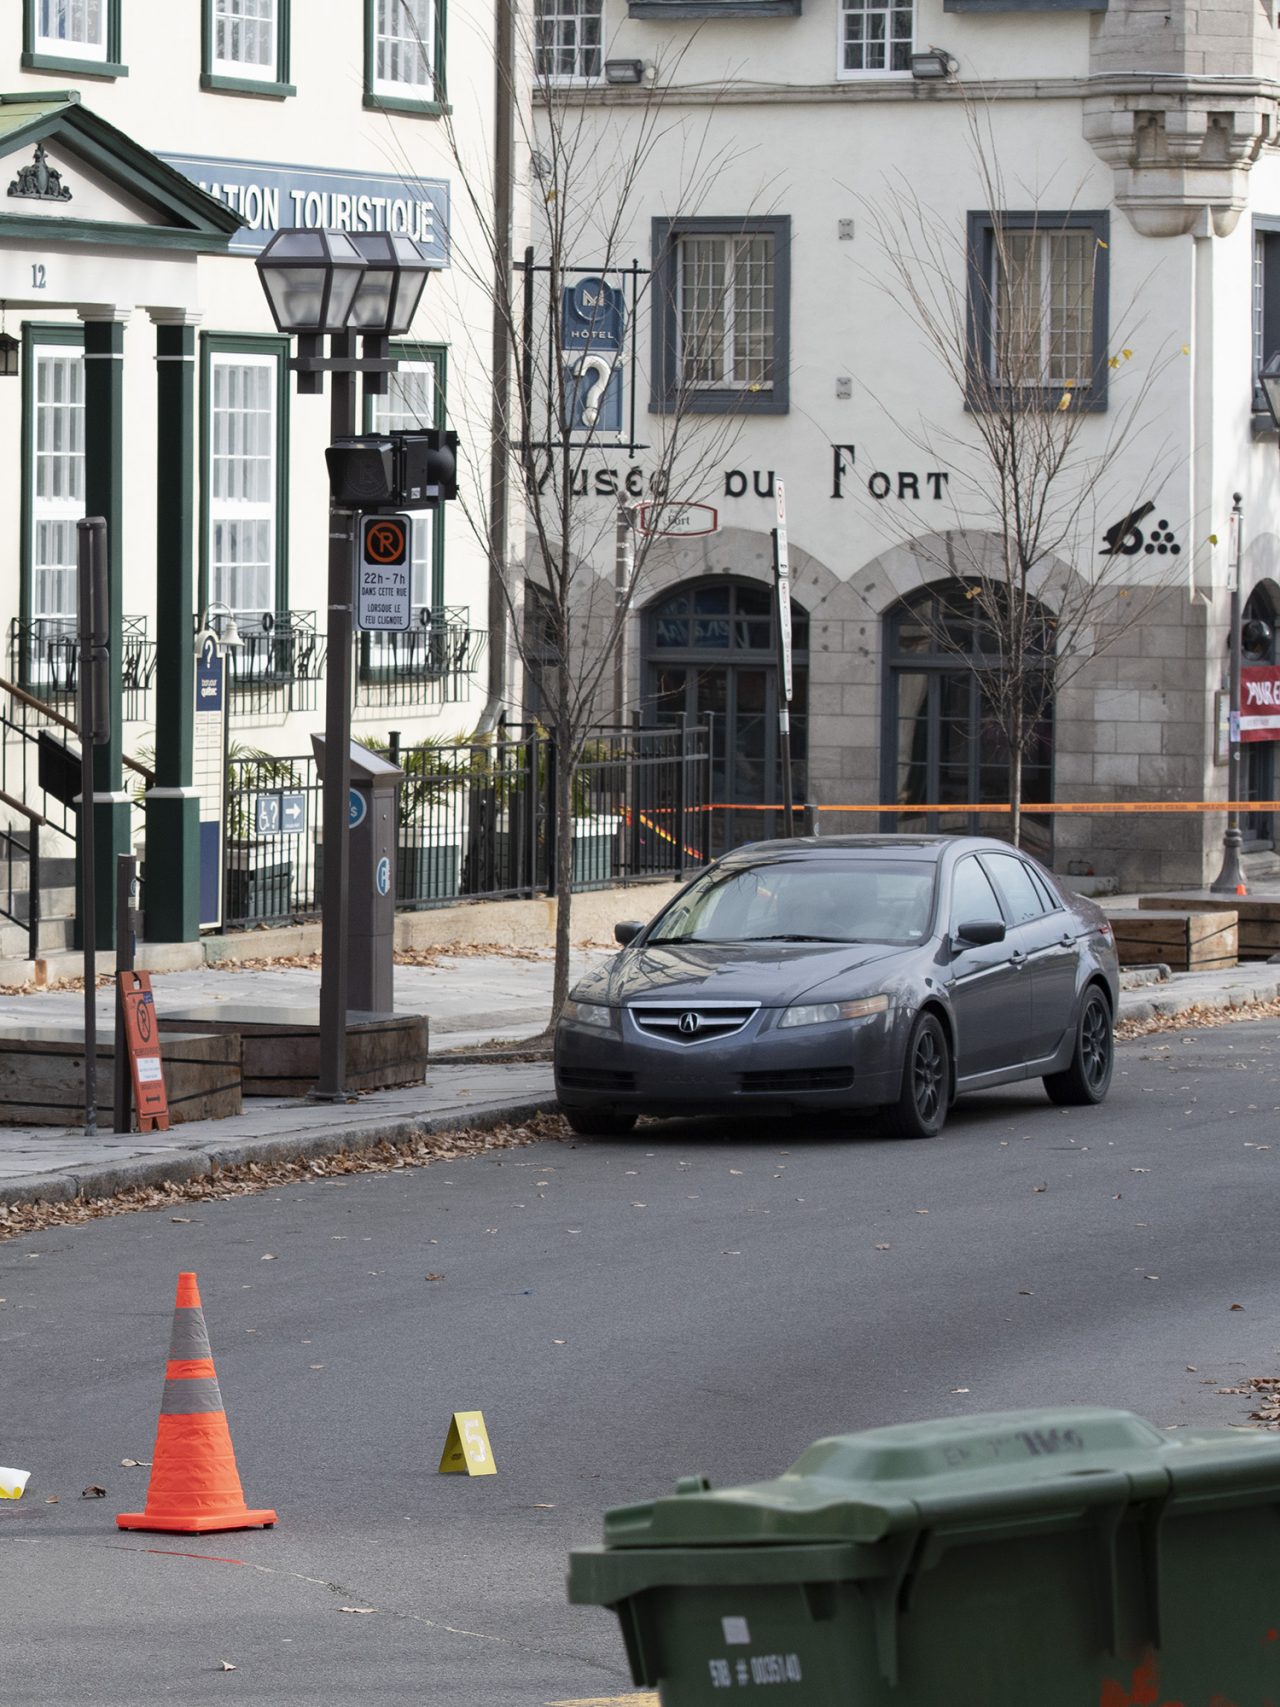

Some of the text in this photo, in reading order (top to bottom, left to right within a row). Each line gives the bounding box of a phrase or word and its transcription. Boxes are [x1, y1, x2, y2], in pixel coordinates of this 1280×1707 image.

[291, 190, 435, 243] TOURISTIQUE
[31, 264, 46, 289] 12
[571, 329, 615, 340] HÔTEL
[364, 572, 383, 584] 22h
[393, 573, 406, 584] 7h
[361, 587, 407, 597] DANS CETTE RUE
[367, 603, 401, 613] LORSQUE LE
[365, 615, 403, 625] FEU CLIGNOTE
[463, 1419, 487, 1463] 5
